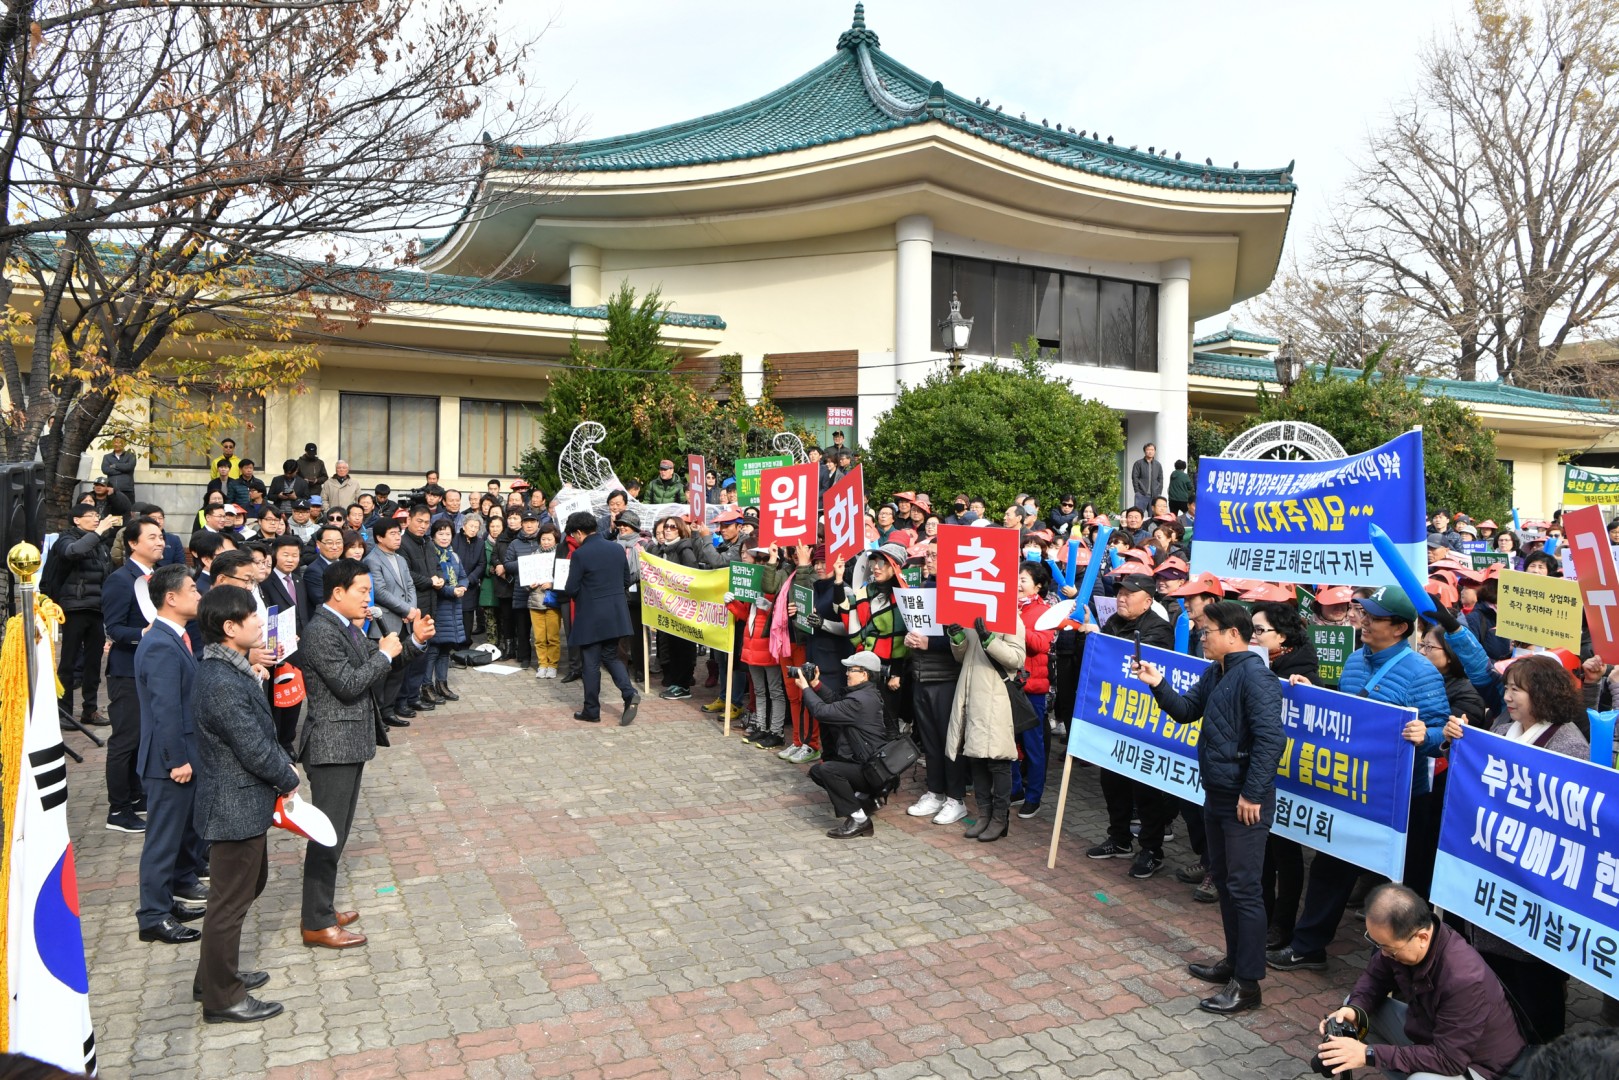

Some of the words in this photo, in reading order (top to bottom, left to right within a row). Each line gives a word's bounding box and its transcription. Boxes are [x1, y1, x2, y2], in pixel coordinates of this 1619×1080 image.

[828, 408, 853, 417] 공원만이
[828, 417, 853, 426] 살길이다
[691, 463, 702, 517] 공
[1206, 470, 1218, 493] 옛
[1216, 471, 1249, 495] 해운대역
[1377, 451, 1401, 480] 약속
[1567, 480, 1596, 493] 부산의
[769, 474, 807, 537] 원
[828, 485, 859, 554] 화
[1218, 500, 1251, 533] 꼭!!
[949, 536, 1006, 622] 촉
[1226, 547, 1374, 576] 새마을문고해운대구지부
[1372, 586, 1387, 601] A
[1502, 584, 1509, 594] 옛
[1512, 586, 1545, 600] 해운대역의
[1549, 593, 1578, 607] 상업화를
[1574, 531, 1618, 642] 구
[1509, 600, 1522, 611] 즉각
[1525, 603, 1553, 616] 중지하라
[1314, 630, 1328, 644] 빌딩
[1329, 631, 1337, 644] 숲
[1338, 631, 1345, 645] 속
[1316, 647, 1343, 662] 주민들의
[1098, 681, 1112, 716] 옛
[1112, 684, 1161, 734] 해운대역
[1303, 703, 1352, 743] 메시지!!
[1298, 741, 1369, 804] 품으로!!
[1481, 753, 1605, 838] 부산시여!
[1470, 806, 1586, 890] 시민에게
[1474, 878, 1618, 978] 바르게살기운
